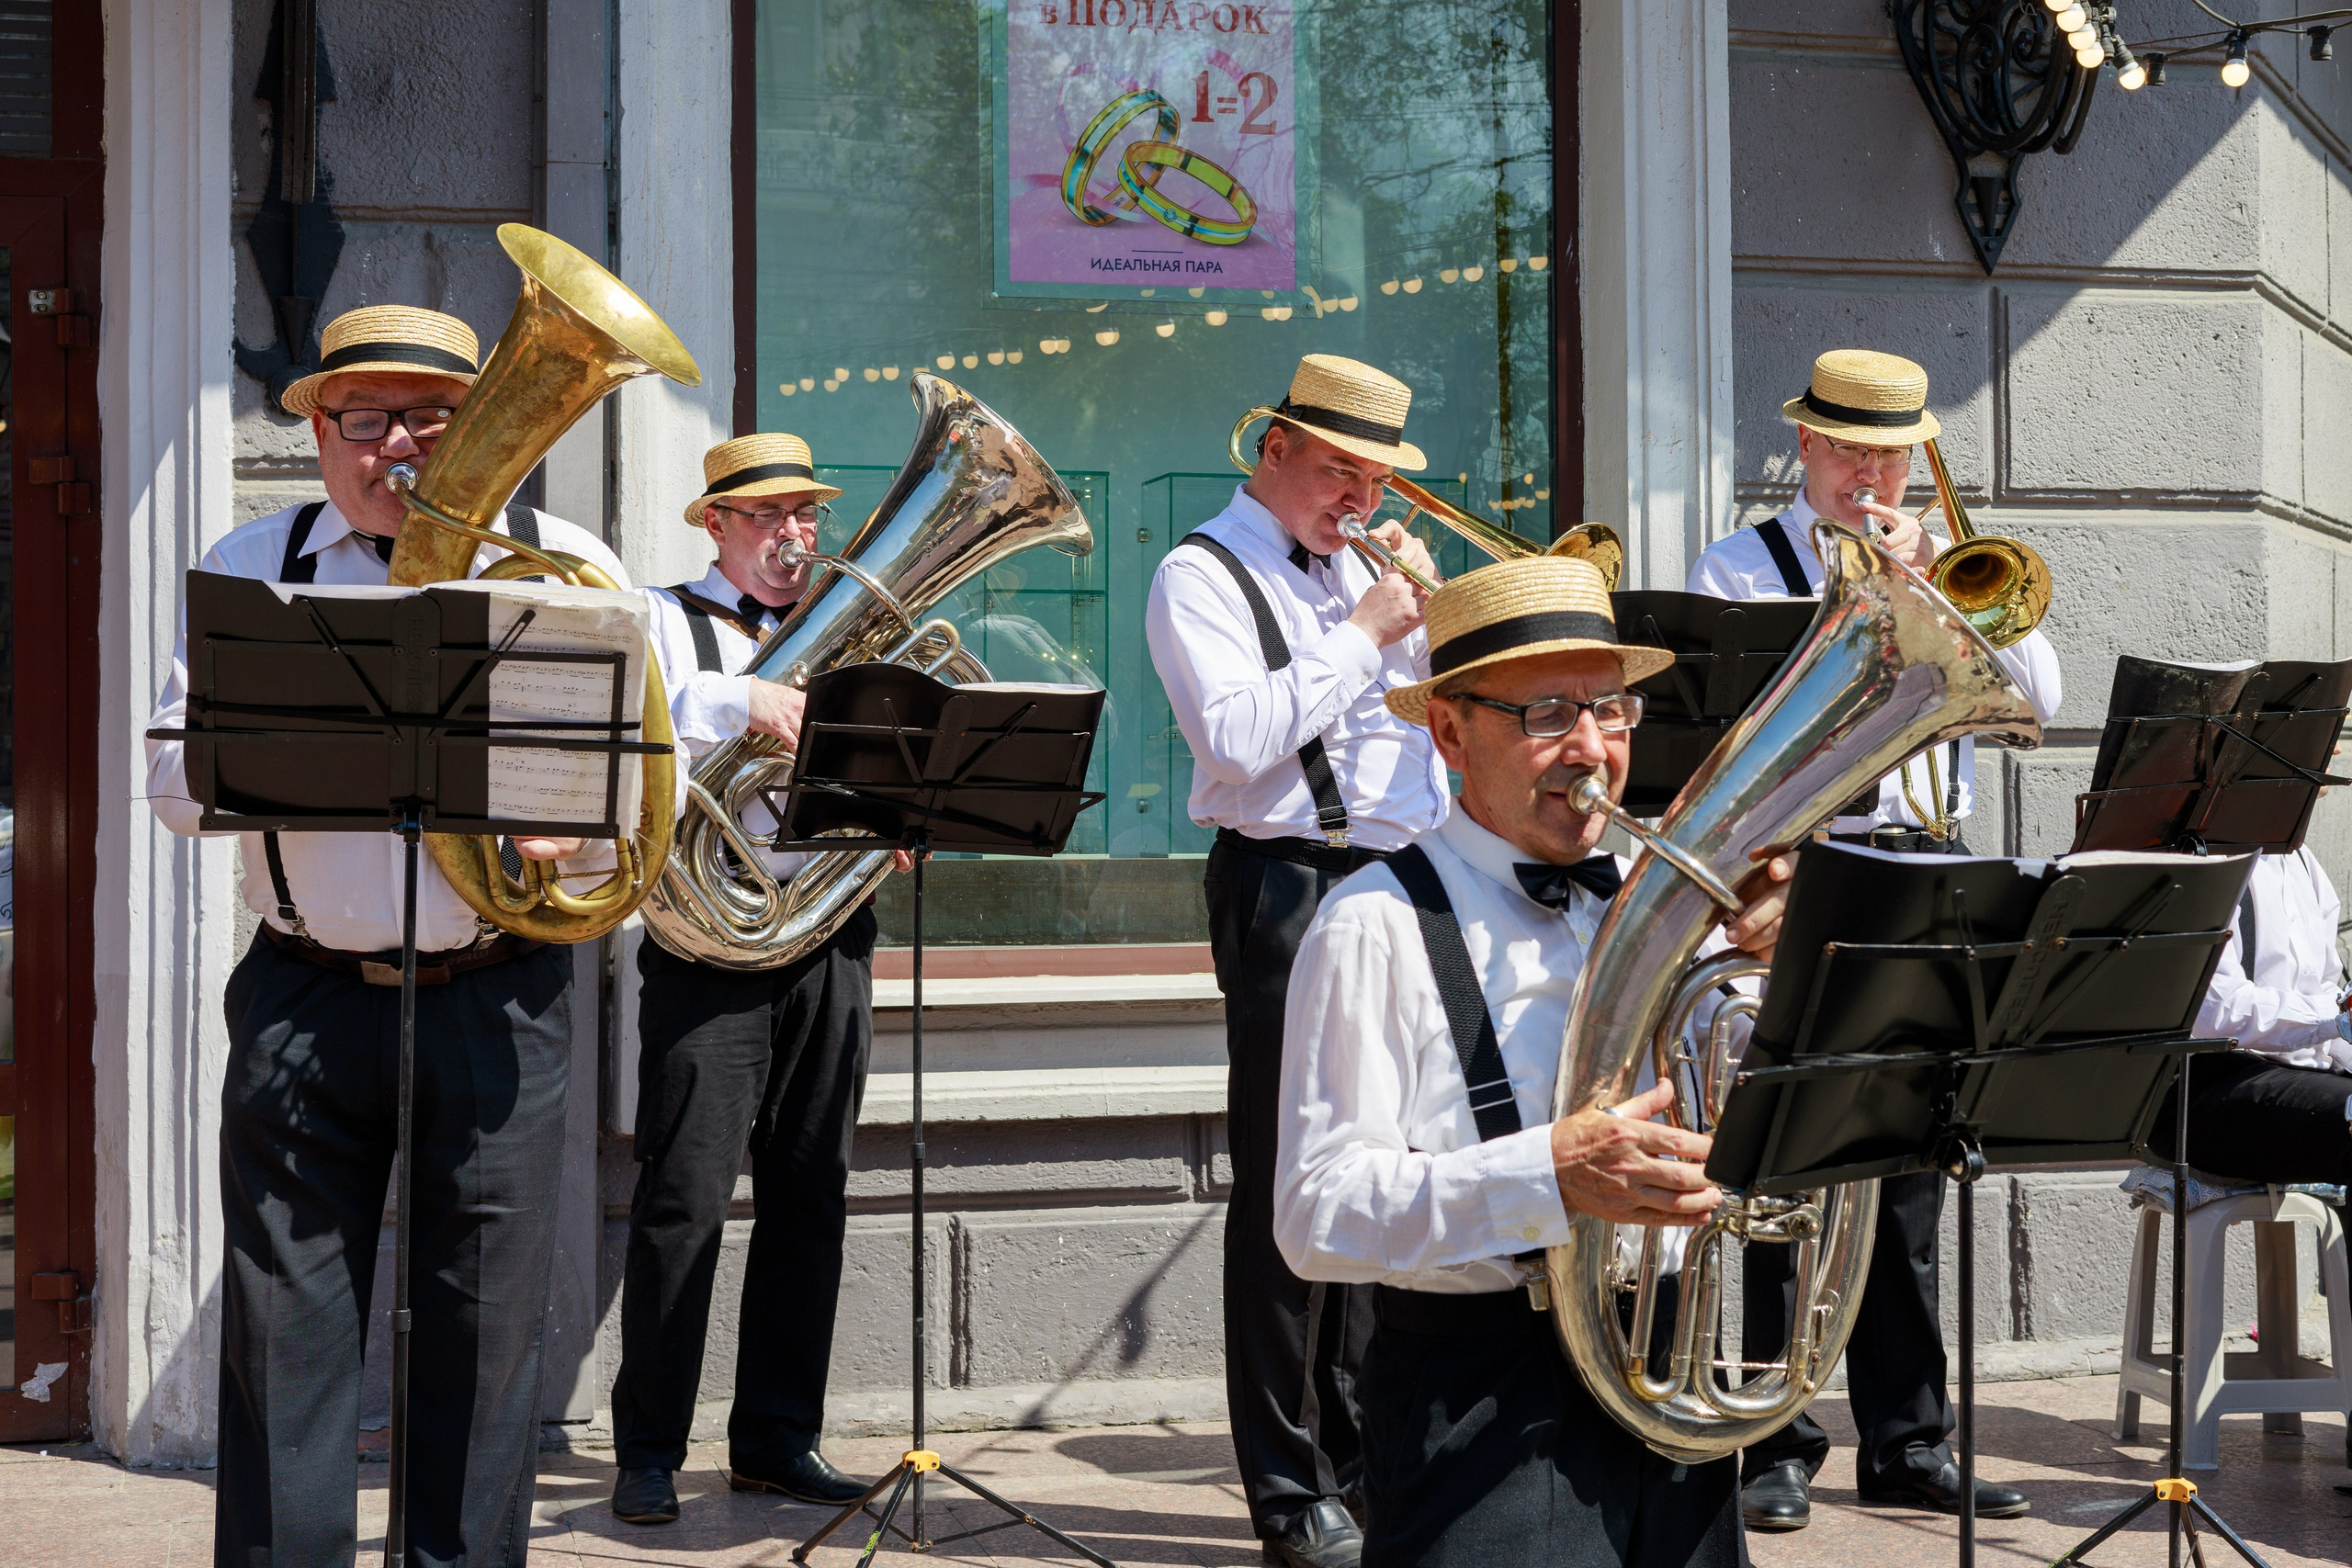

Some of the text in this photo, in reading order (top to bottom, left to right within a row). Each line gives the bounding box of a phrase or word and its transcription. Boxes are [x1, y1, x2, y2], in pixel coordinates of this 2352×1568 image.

[1068, 0, 1270, 35] ПОДАРОК
[1191, 70, 1278, 135] 1=2
[1091, 257, 1223, 274] ИДЕАЛЬНАЯ ПАРА
